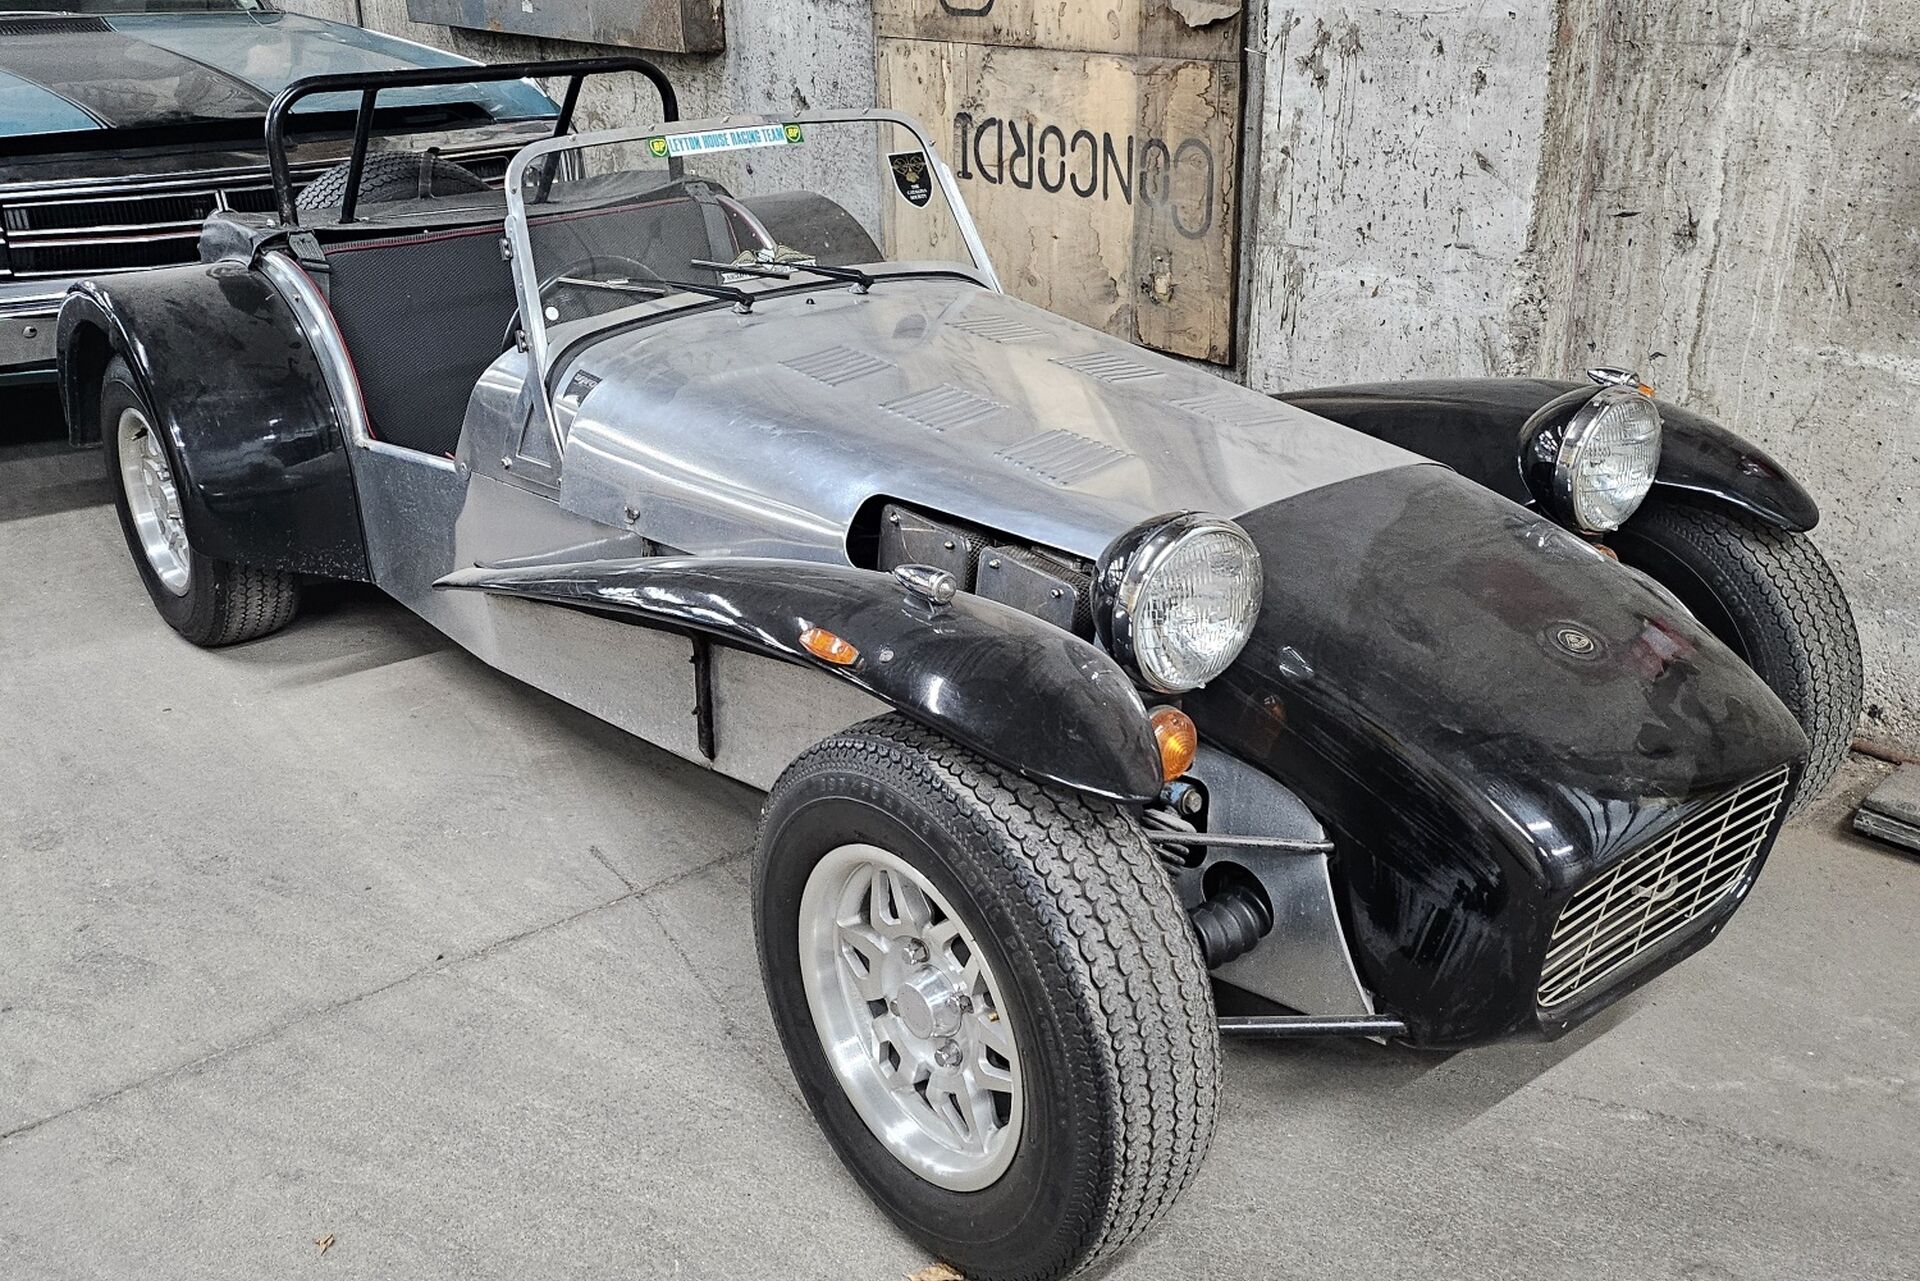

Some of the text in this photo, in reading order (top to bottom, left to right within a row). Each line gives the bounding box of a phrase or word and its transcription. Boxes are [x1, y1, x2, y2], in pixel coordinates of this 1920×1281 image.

[668, 126, 786, 152] LEYTON HOUSE RACING TEAM
